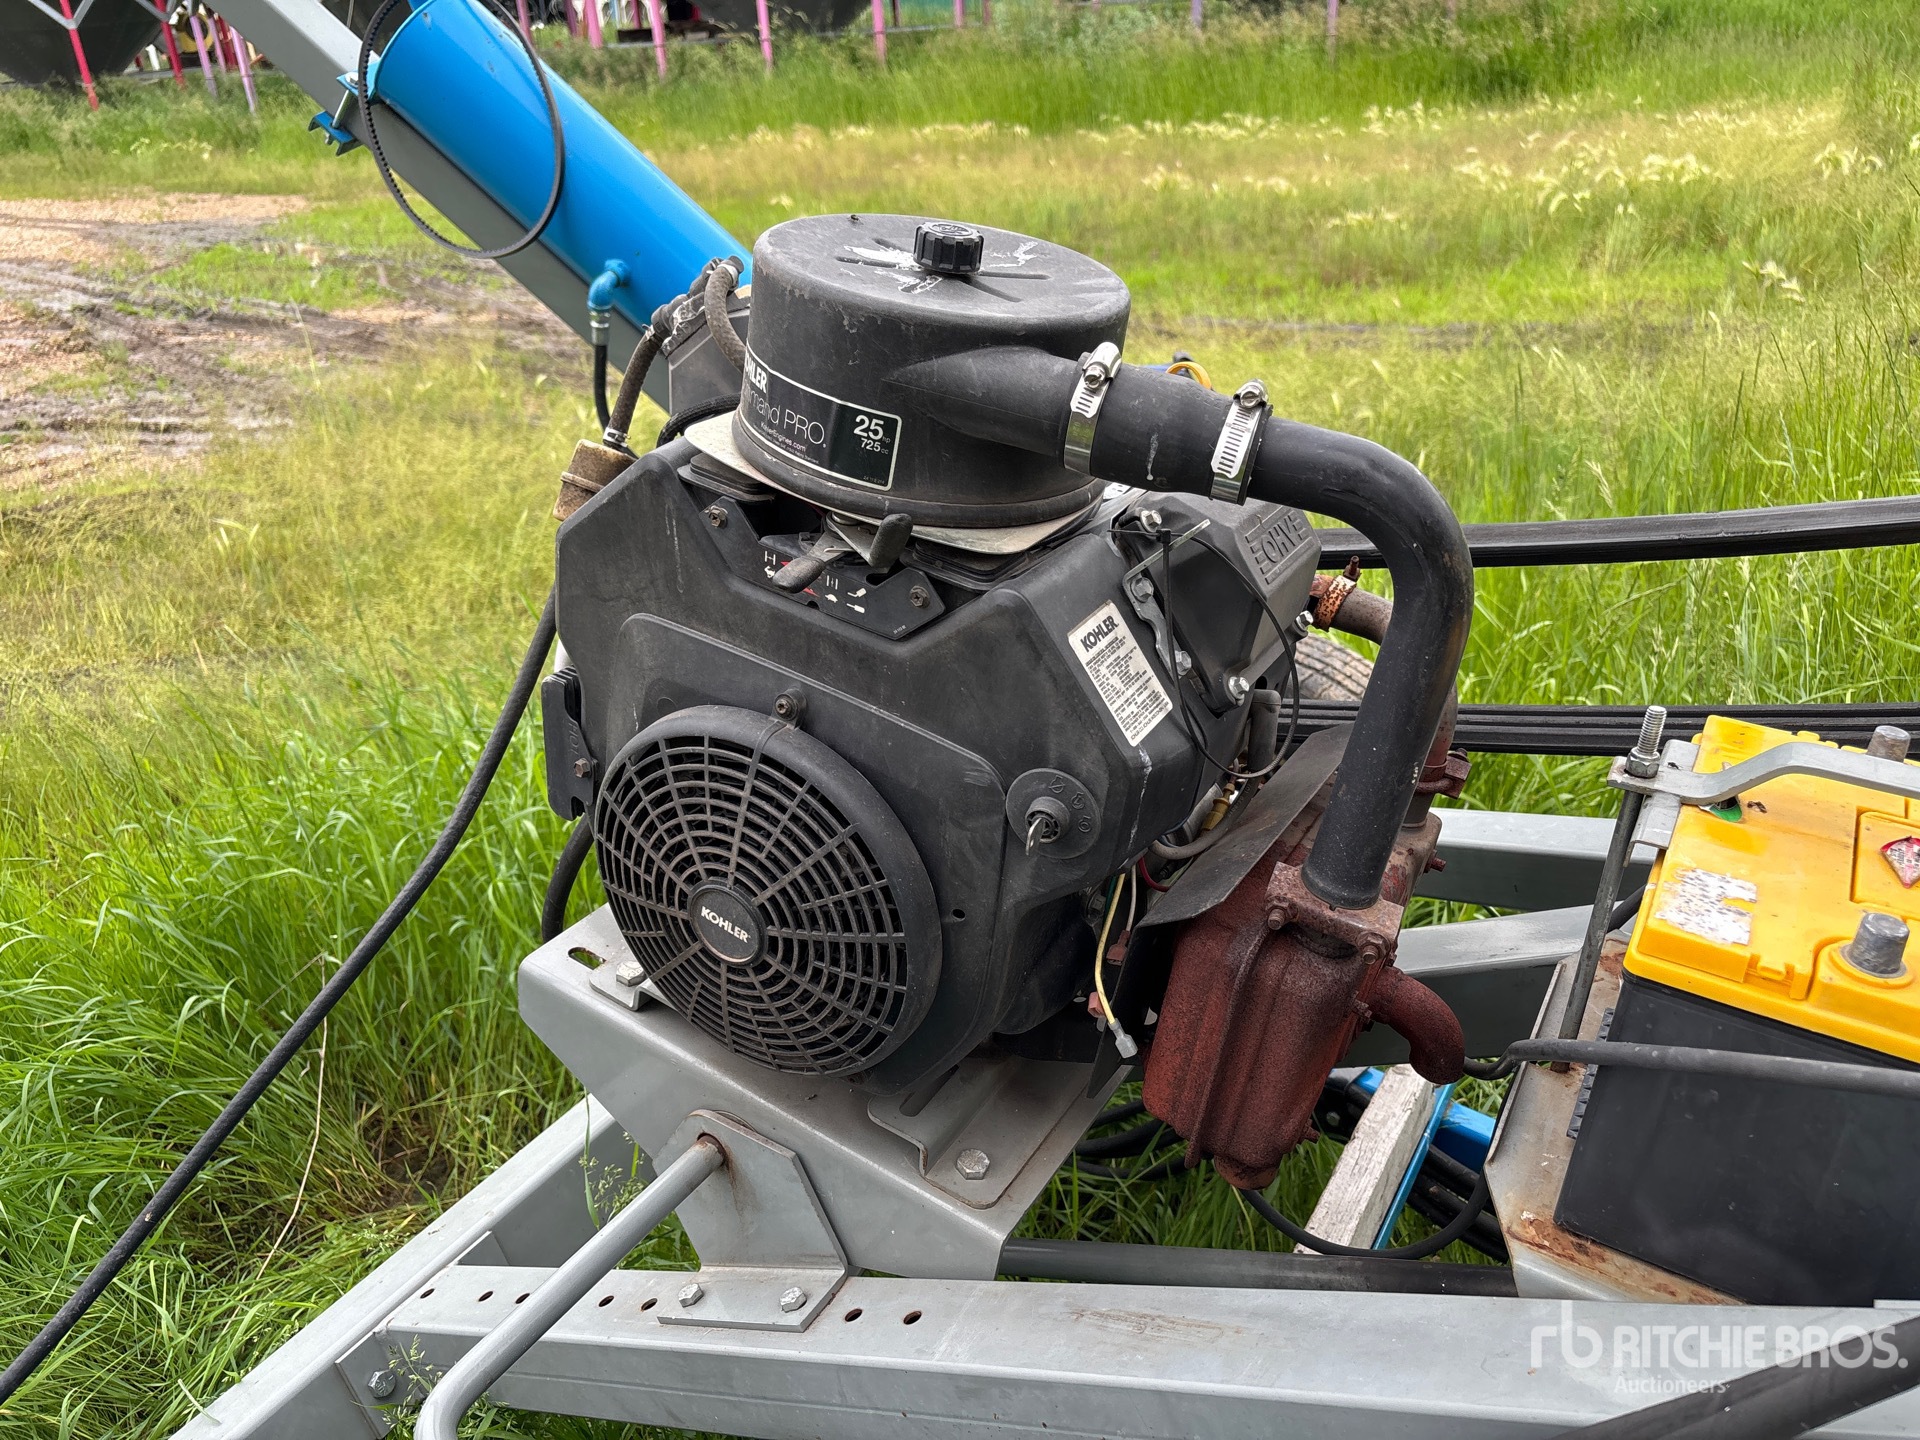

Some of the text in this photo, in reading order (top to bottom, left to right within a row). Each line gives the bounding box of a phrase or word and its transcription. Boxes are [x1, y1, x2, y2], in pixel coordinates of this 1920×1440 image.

[744, 350, 768, 394] OHLER
[783, 408, 825, 445] PRO
[854, 414, 885, 441] 25
[860, 437, 881, 453] 725
[1080, 615, 1119, 653] KOHLER
[701, 905, 749, 944] KOHLER
